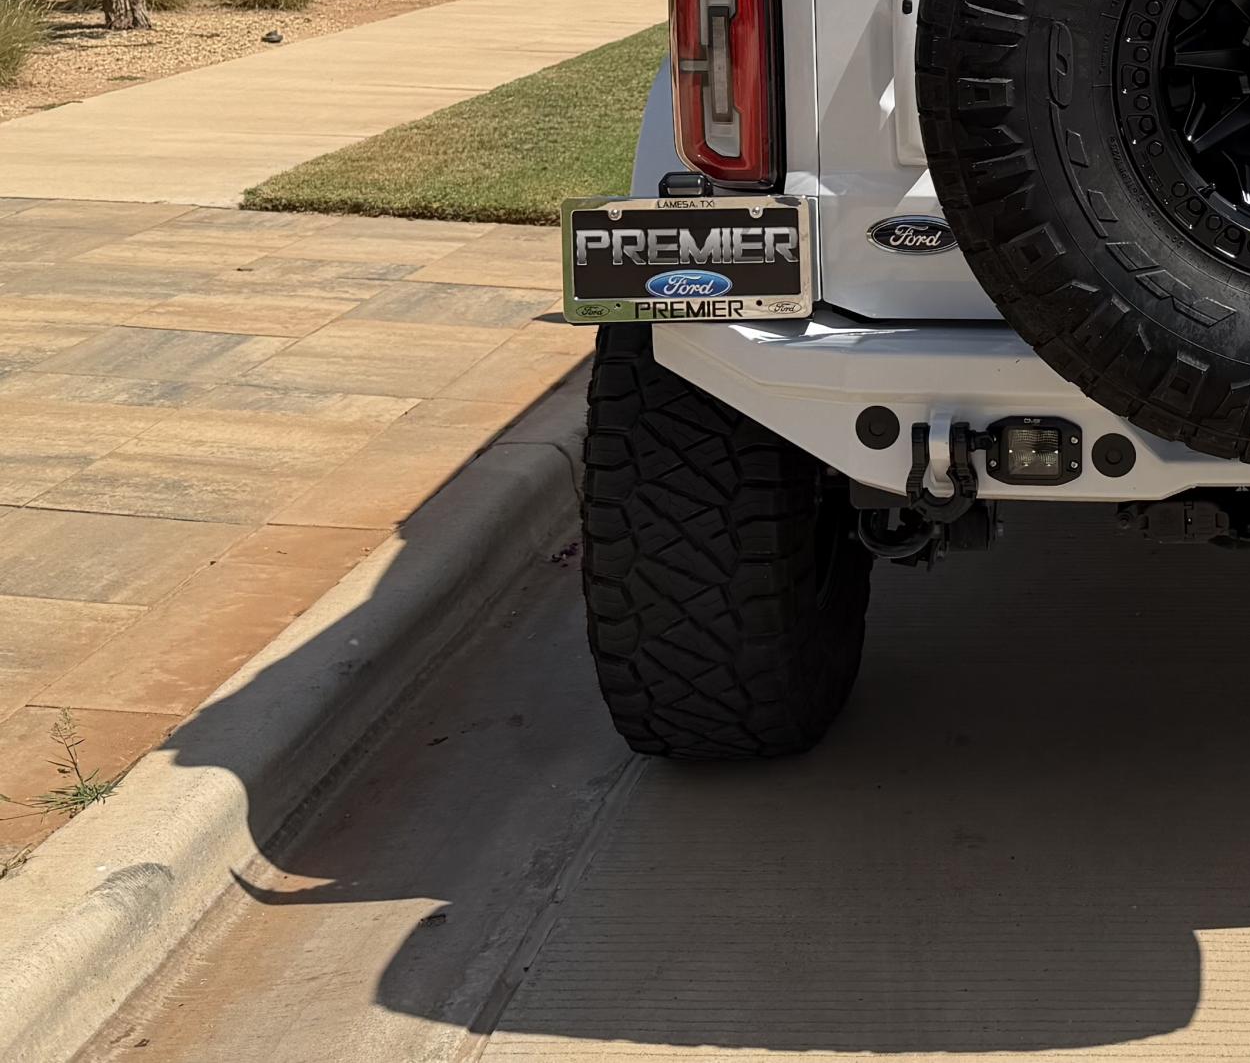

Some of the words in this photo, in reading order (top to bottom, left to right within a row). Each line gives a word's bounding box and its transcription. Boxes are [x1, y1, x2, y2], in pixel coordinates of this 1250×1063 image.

[890, 224, 942, 246] Ford
[576, 227, 799, 265] PREMIER
[663, 274, 714, 295] Ford
[635, 300, 743, 319] PREMIER
